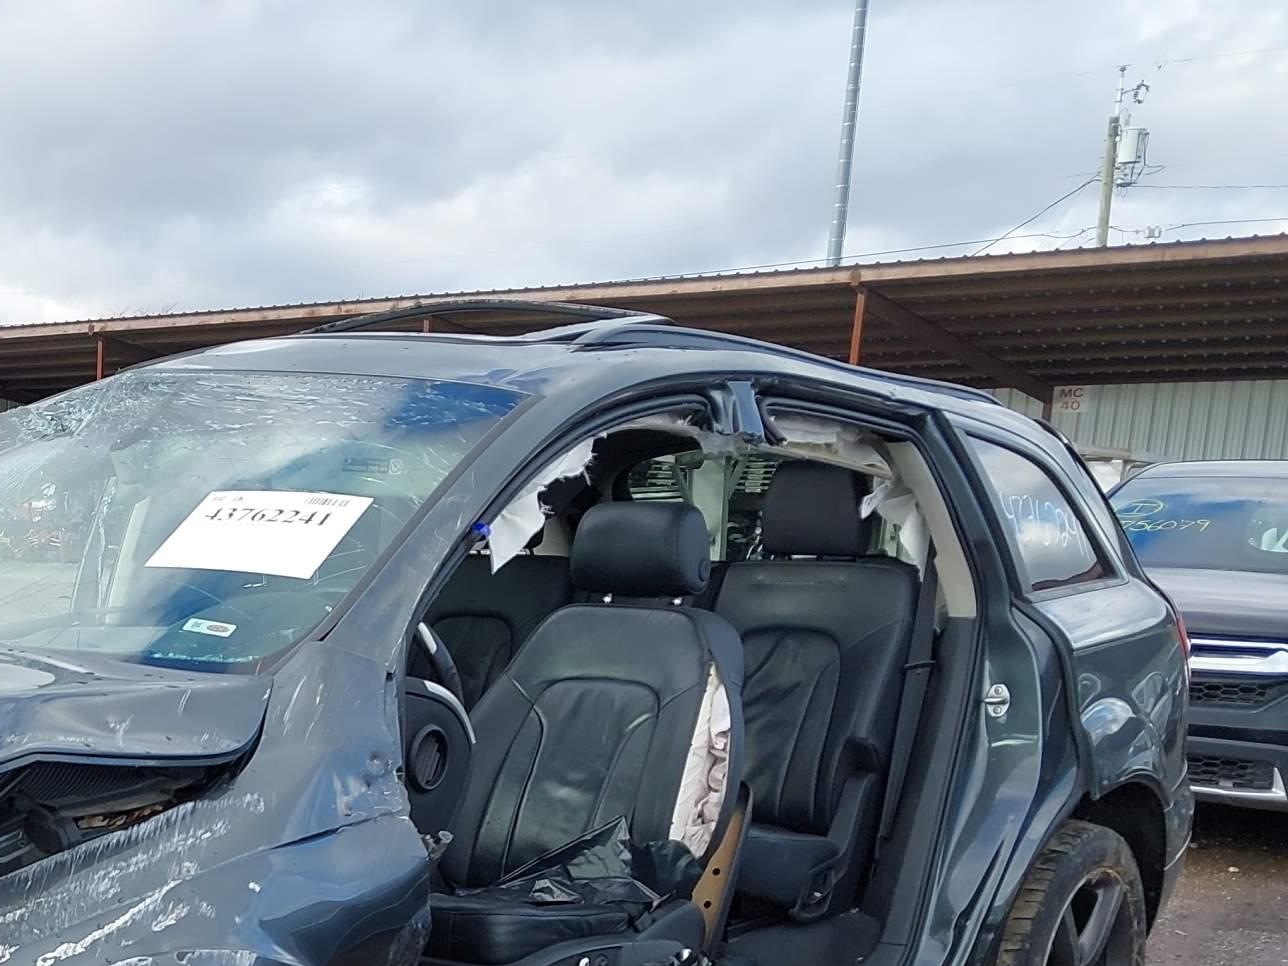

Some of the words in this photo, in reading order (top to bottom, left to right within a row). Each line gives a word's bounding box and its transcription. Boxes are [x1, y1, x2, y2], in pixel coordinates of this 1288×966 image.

[1060, 388, 1083, 398] MC
[1061, 400, 1080, 410] 40
[204, 507, 332, 526] 43762241
